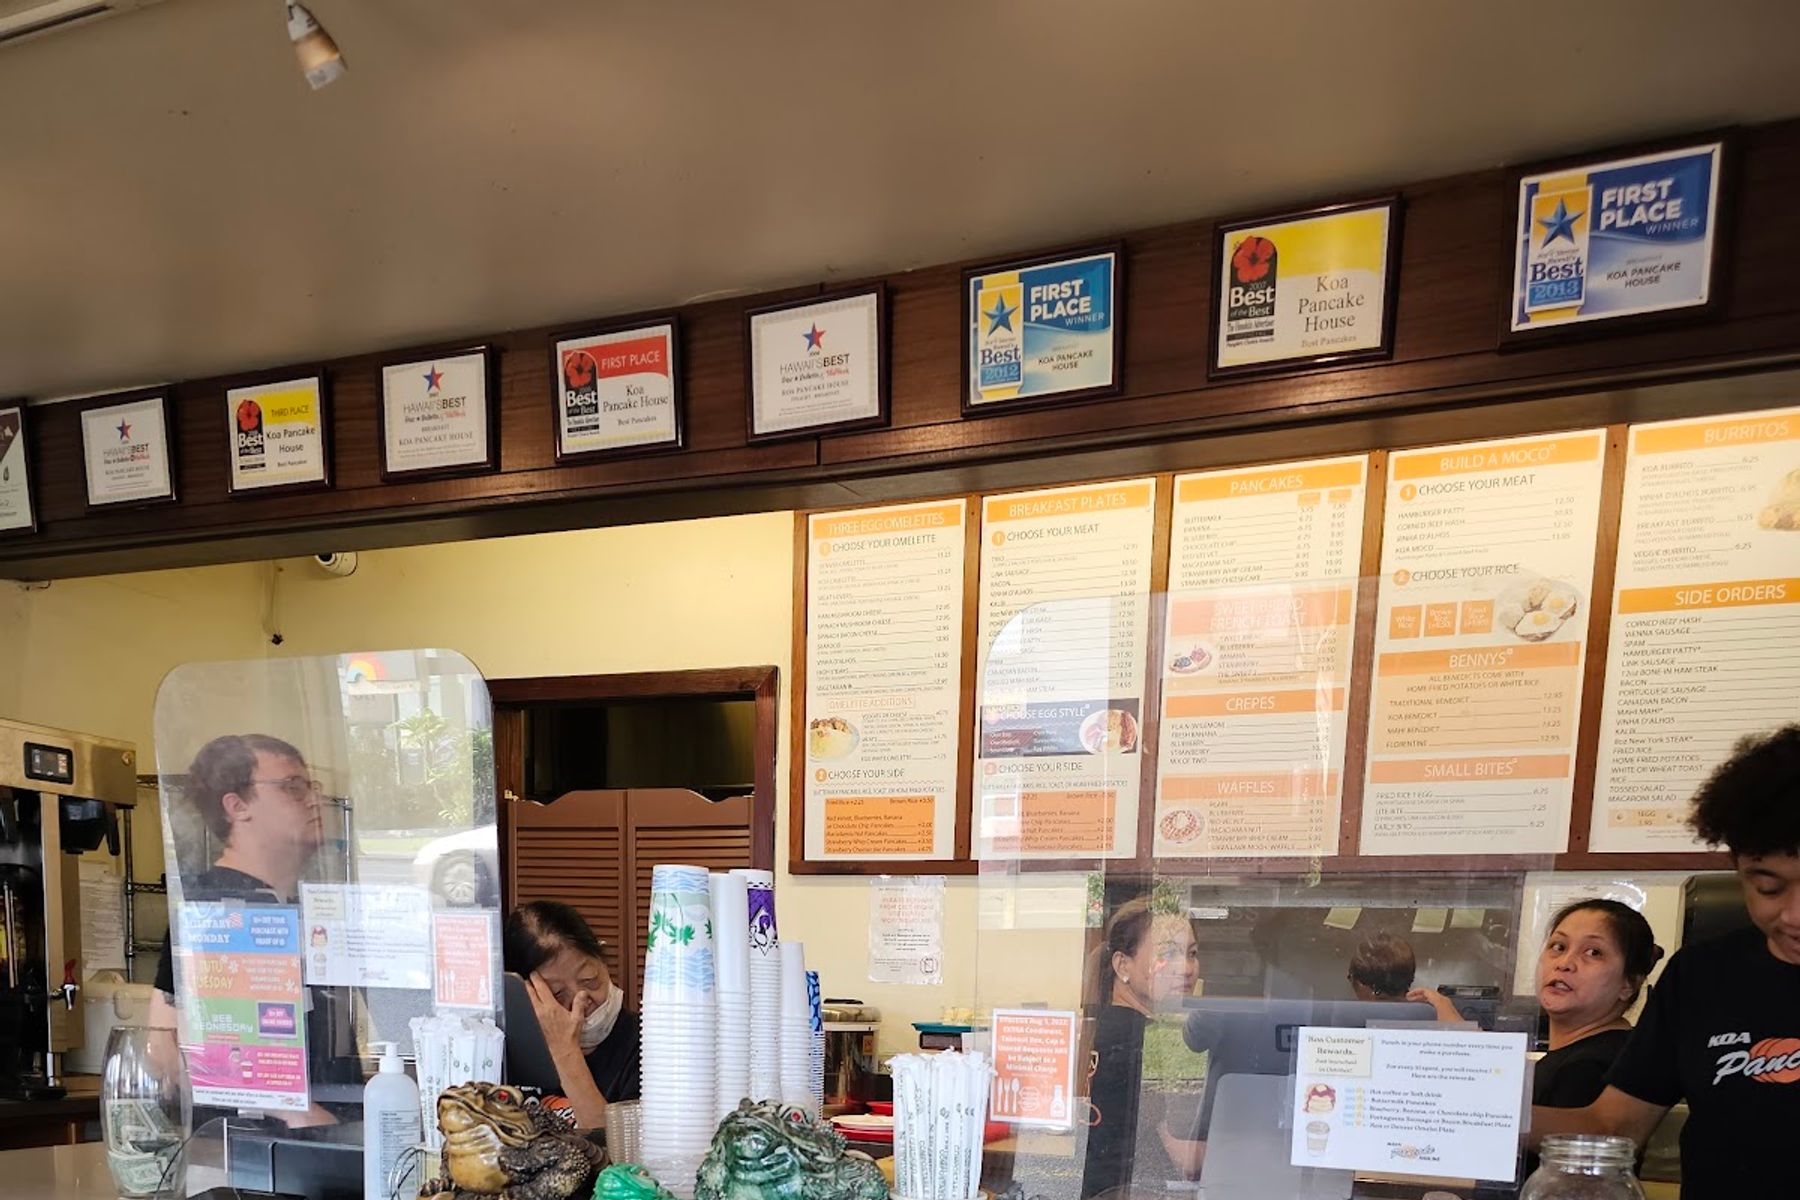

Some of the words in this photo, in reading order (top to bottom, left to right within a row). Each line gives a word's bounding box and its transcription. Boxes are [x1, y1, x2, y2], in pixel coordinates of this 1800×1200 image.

[1601, 177, 1674, 209] FIRST
[1600, 198, 1682, 231] PLACE
[1645, 218, 1699, 235] WINNER
[1530, 257, 1583, 283] Best
[1607, 270, 1627, 280] KOA
[1631, 262, 1681, 277] PANCAKE
[1317, 276, 1348, 292] Koa
[1535, 280, 1578, 298] 2013
[1625, 275, 1660, 288] HOUSE
[1030, 279, 1083, 304] FIRST
[1230, 286, 1275, 308] Best
[1031, 296, 1091, 321] PLACE
[1298, 292, 1364, 314] Pancake
[1065, 313, 1104, 326] WINNER
[1305, 315, 1355, 332] House
[601, 356, 626, 370] FIRST
[630, 351, 660, 366] PLACE
[823, 353, 850, 367] BEST
[980, 345, 1021, 365] Best
[1038, 356, 1054, 364] KOA
[1056, 350, 1093, 362] PANCAKE
[985, 364, 1018, 380] 2012
[567, 390, 598, 407] Best
[626, 385, 644, 396] Koa
[290, 405, 309, 415] PLACE
[442, 396, 466, 409] BEST
[603, 400, 637, 412] Pancake
[641, 395, 669, 407] House
[239, 433, 263, 447] Best
[284, 427, 315, 438] Pancake
[1704, 421, 1789, 443] BURRITOS
[279, 444, 303, 453] House
[1440, 454, 1484, 472] BUILD
[1488, 455, 1498, 467] A
[1500, 446, 1550, 463] MOCO
[1230, 474, 1304, 494] PANCAKES
[1419, 481, 1465, 496] CHOOSE
[1468, 477, 1500, 490] YOUR
[1502, 474, 1536, 487] MEAT
[1009, 498, 1077, 517] BREAKFAST
[1081, 492, 1127, 508] PLATES
[1007, 528, 1045, 541] CHOOSE
[1048, 526, 1072, 537] YOUR
[1074, 524, 1100, 534] MEAT
[1412, 567, 1458, 581] CHOOSE
[1461, 566, 1490, 578] YOUR
[1494, 563, 1519, 574] RICE
[1675, 590, 1713, 606] SIDE
[1717, 584, 1786, 601] ORDERS
[1449, 653, 1506, 668] BENNYS
[1225, 696, 1275, 711] CREPES
[1038, 708, 1057, 718] EGG
[1059, 707, 1085, 717] STYLE
[828, 769, 860, 780] CHOOSE
[863, 768, 884, 779] YOUR
[886, 768, 905, 778] SIDE
[999, 763, 1034, 773] CHOOSE
[1037, 763, 1062, 772] YOUR
[1063, 762, 1083, 771] SIDE
[1424, 763, 1470, 778] SMALL
[1475, 761, 1514, 776] BITES
[1217, 781, 1274, 794] WAFFLES
[1707, 1032, 1751, 1048] KOA
